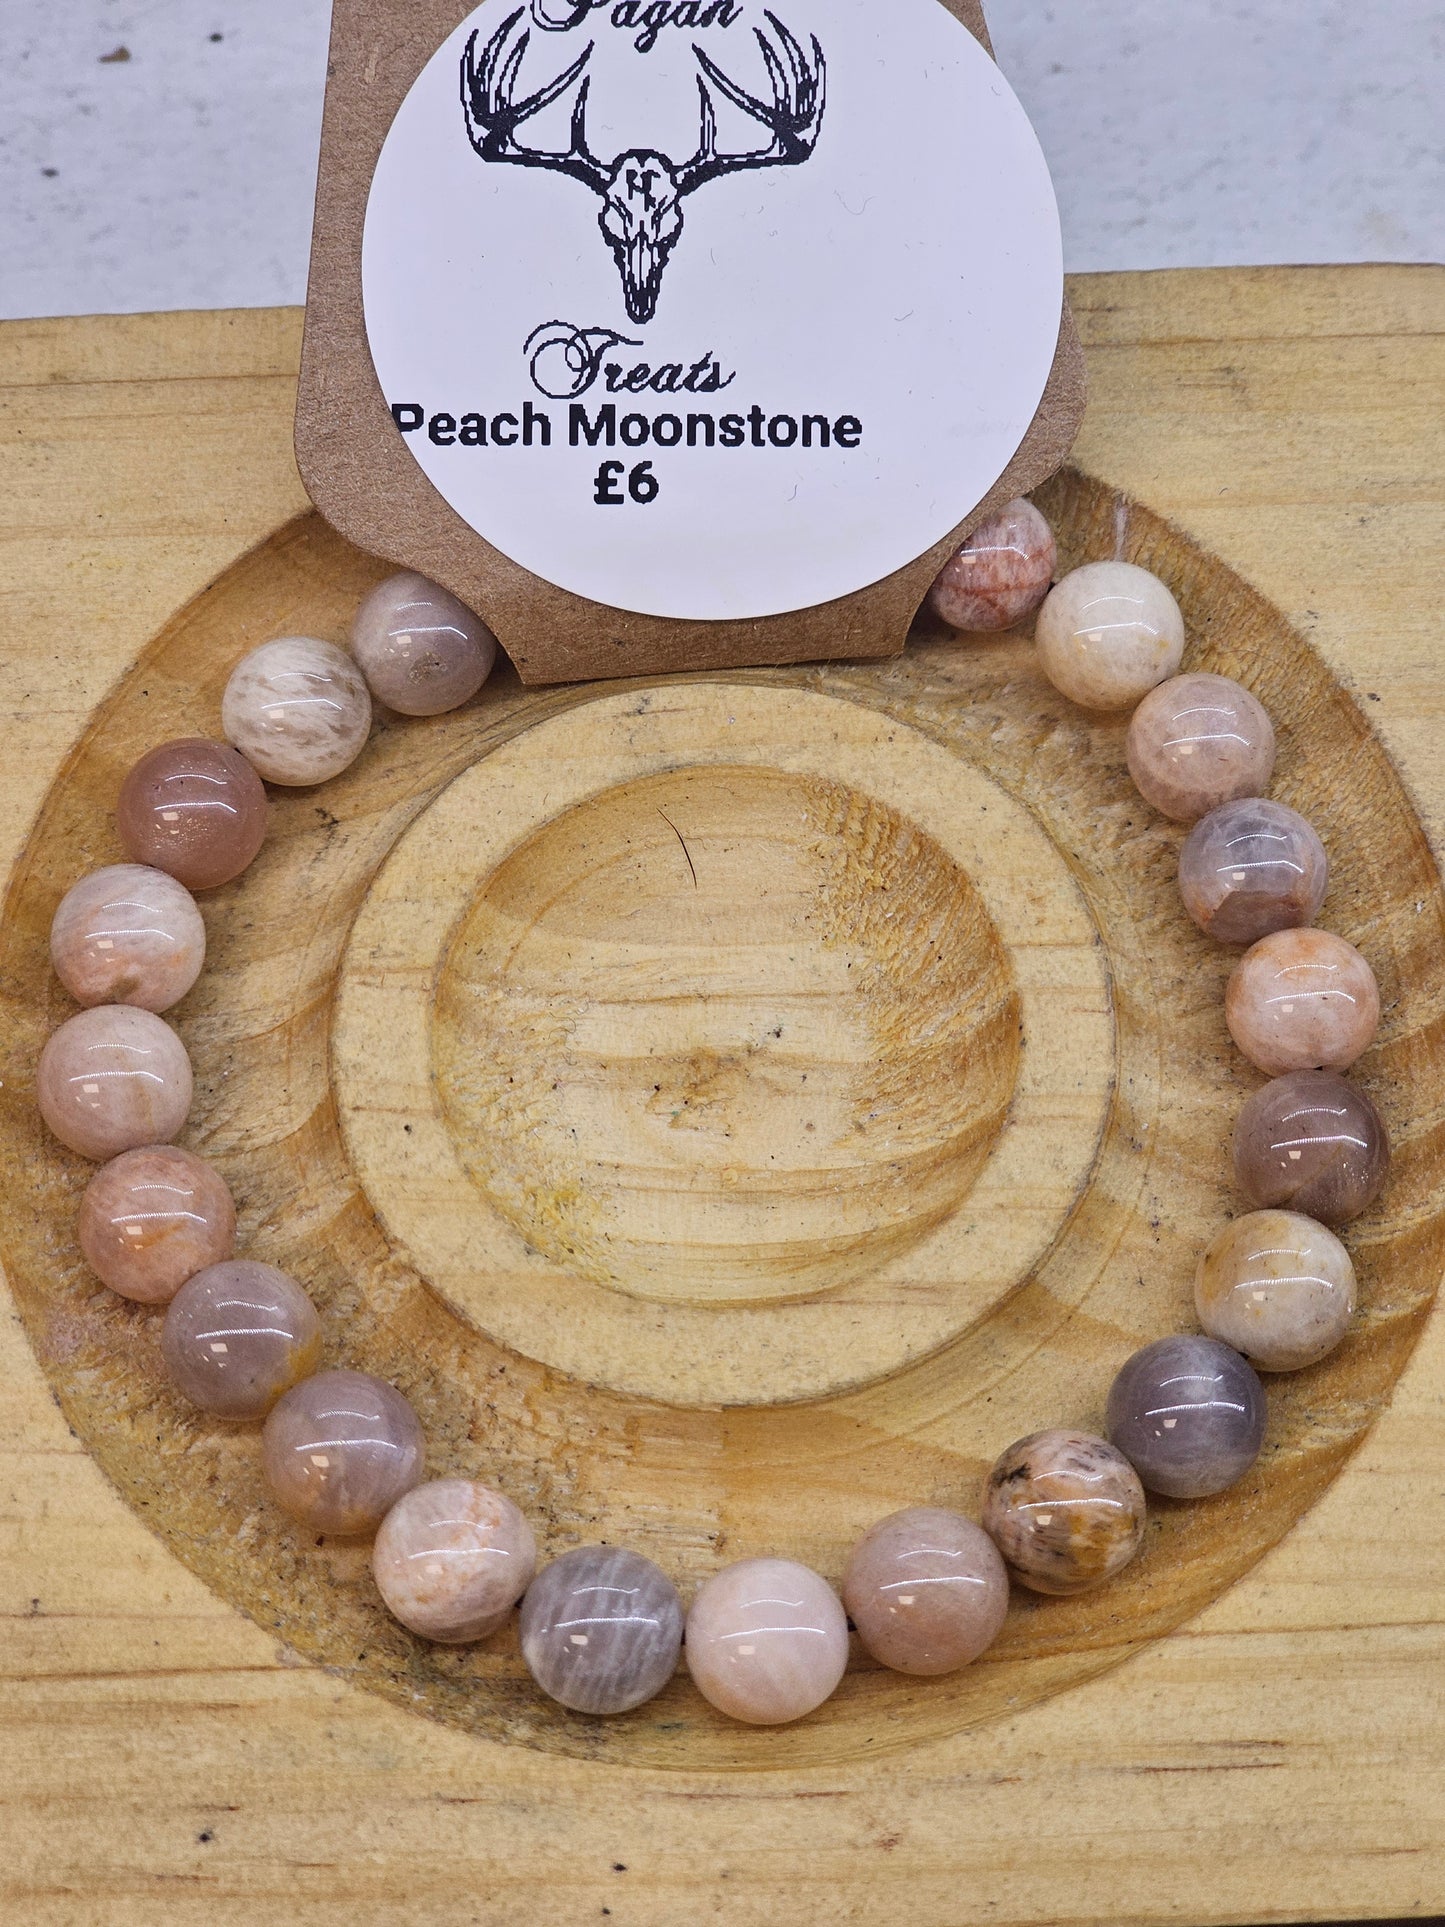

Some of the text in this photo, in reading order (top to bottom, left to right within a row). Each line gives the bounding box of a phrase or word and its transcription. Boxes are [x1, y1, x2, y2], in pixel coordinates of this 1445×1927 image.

[523, 319, 736, 399] Treats
[391, 401, 863, 448] Peach Moonstone
[593, 461, 660, 505] £6
